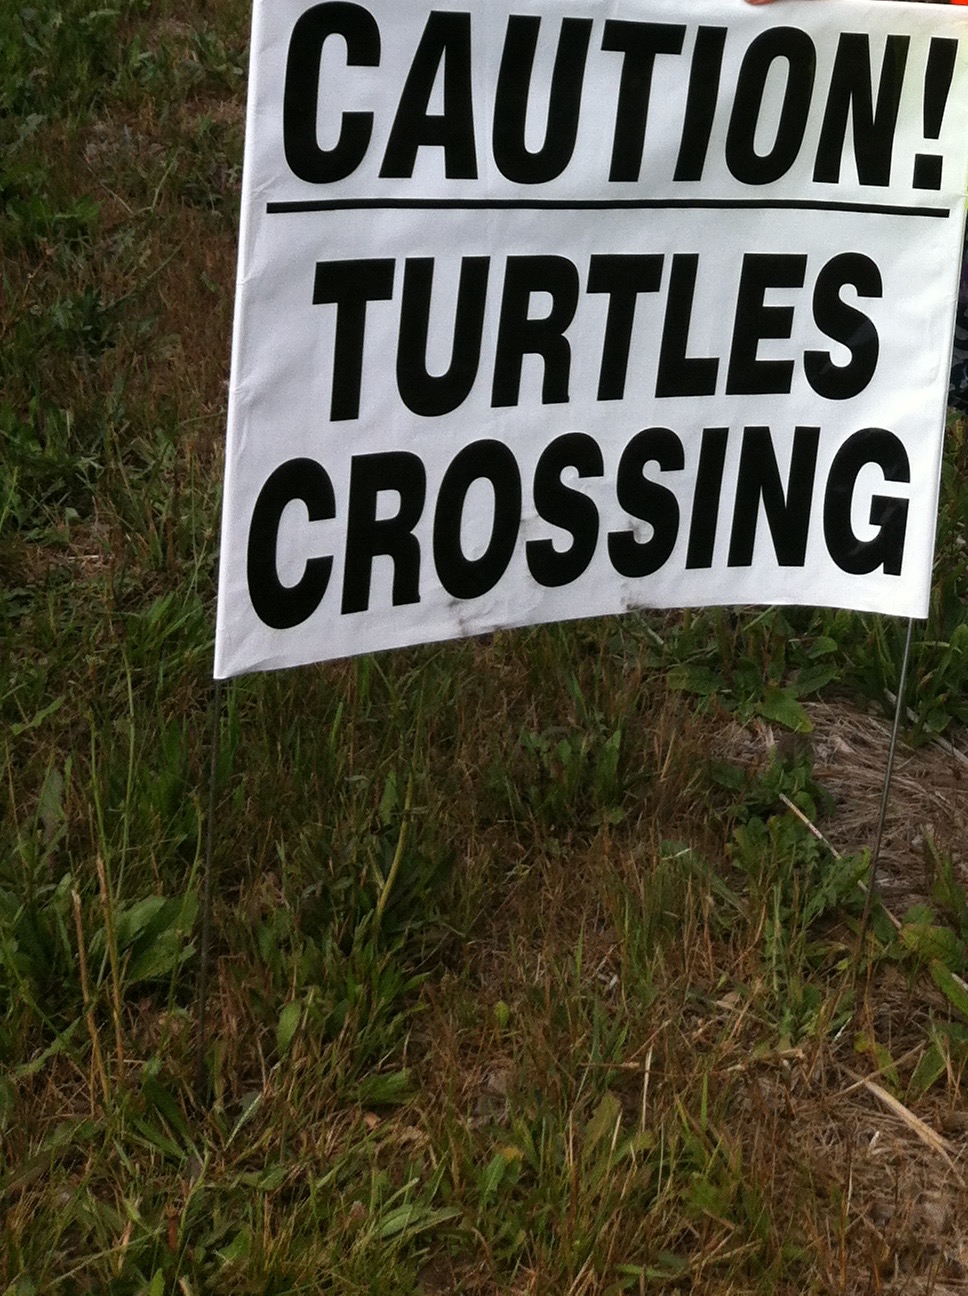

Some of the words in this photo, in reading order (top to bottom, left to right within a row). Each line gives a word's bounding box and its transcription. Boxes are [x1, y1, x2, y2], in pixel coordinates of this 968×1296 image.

[283, 1, 959, 191] CAUTION!
[312, 252, 883, 422] TURTLES
[246, 426, 911, 630] CROSSING
